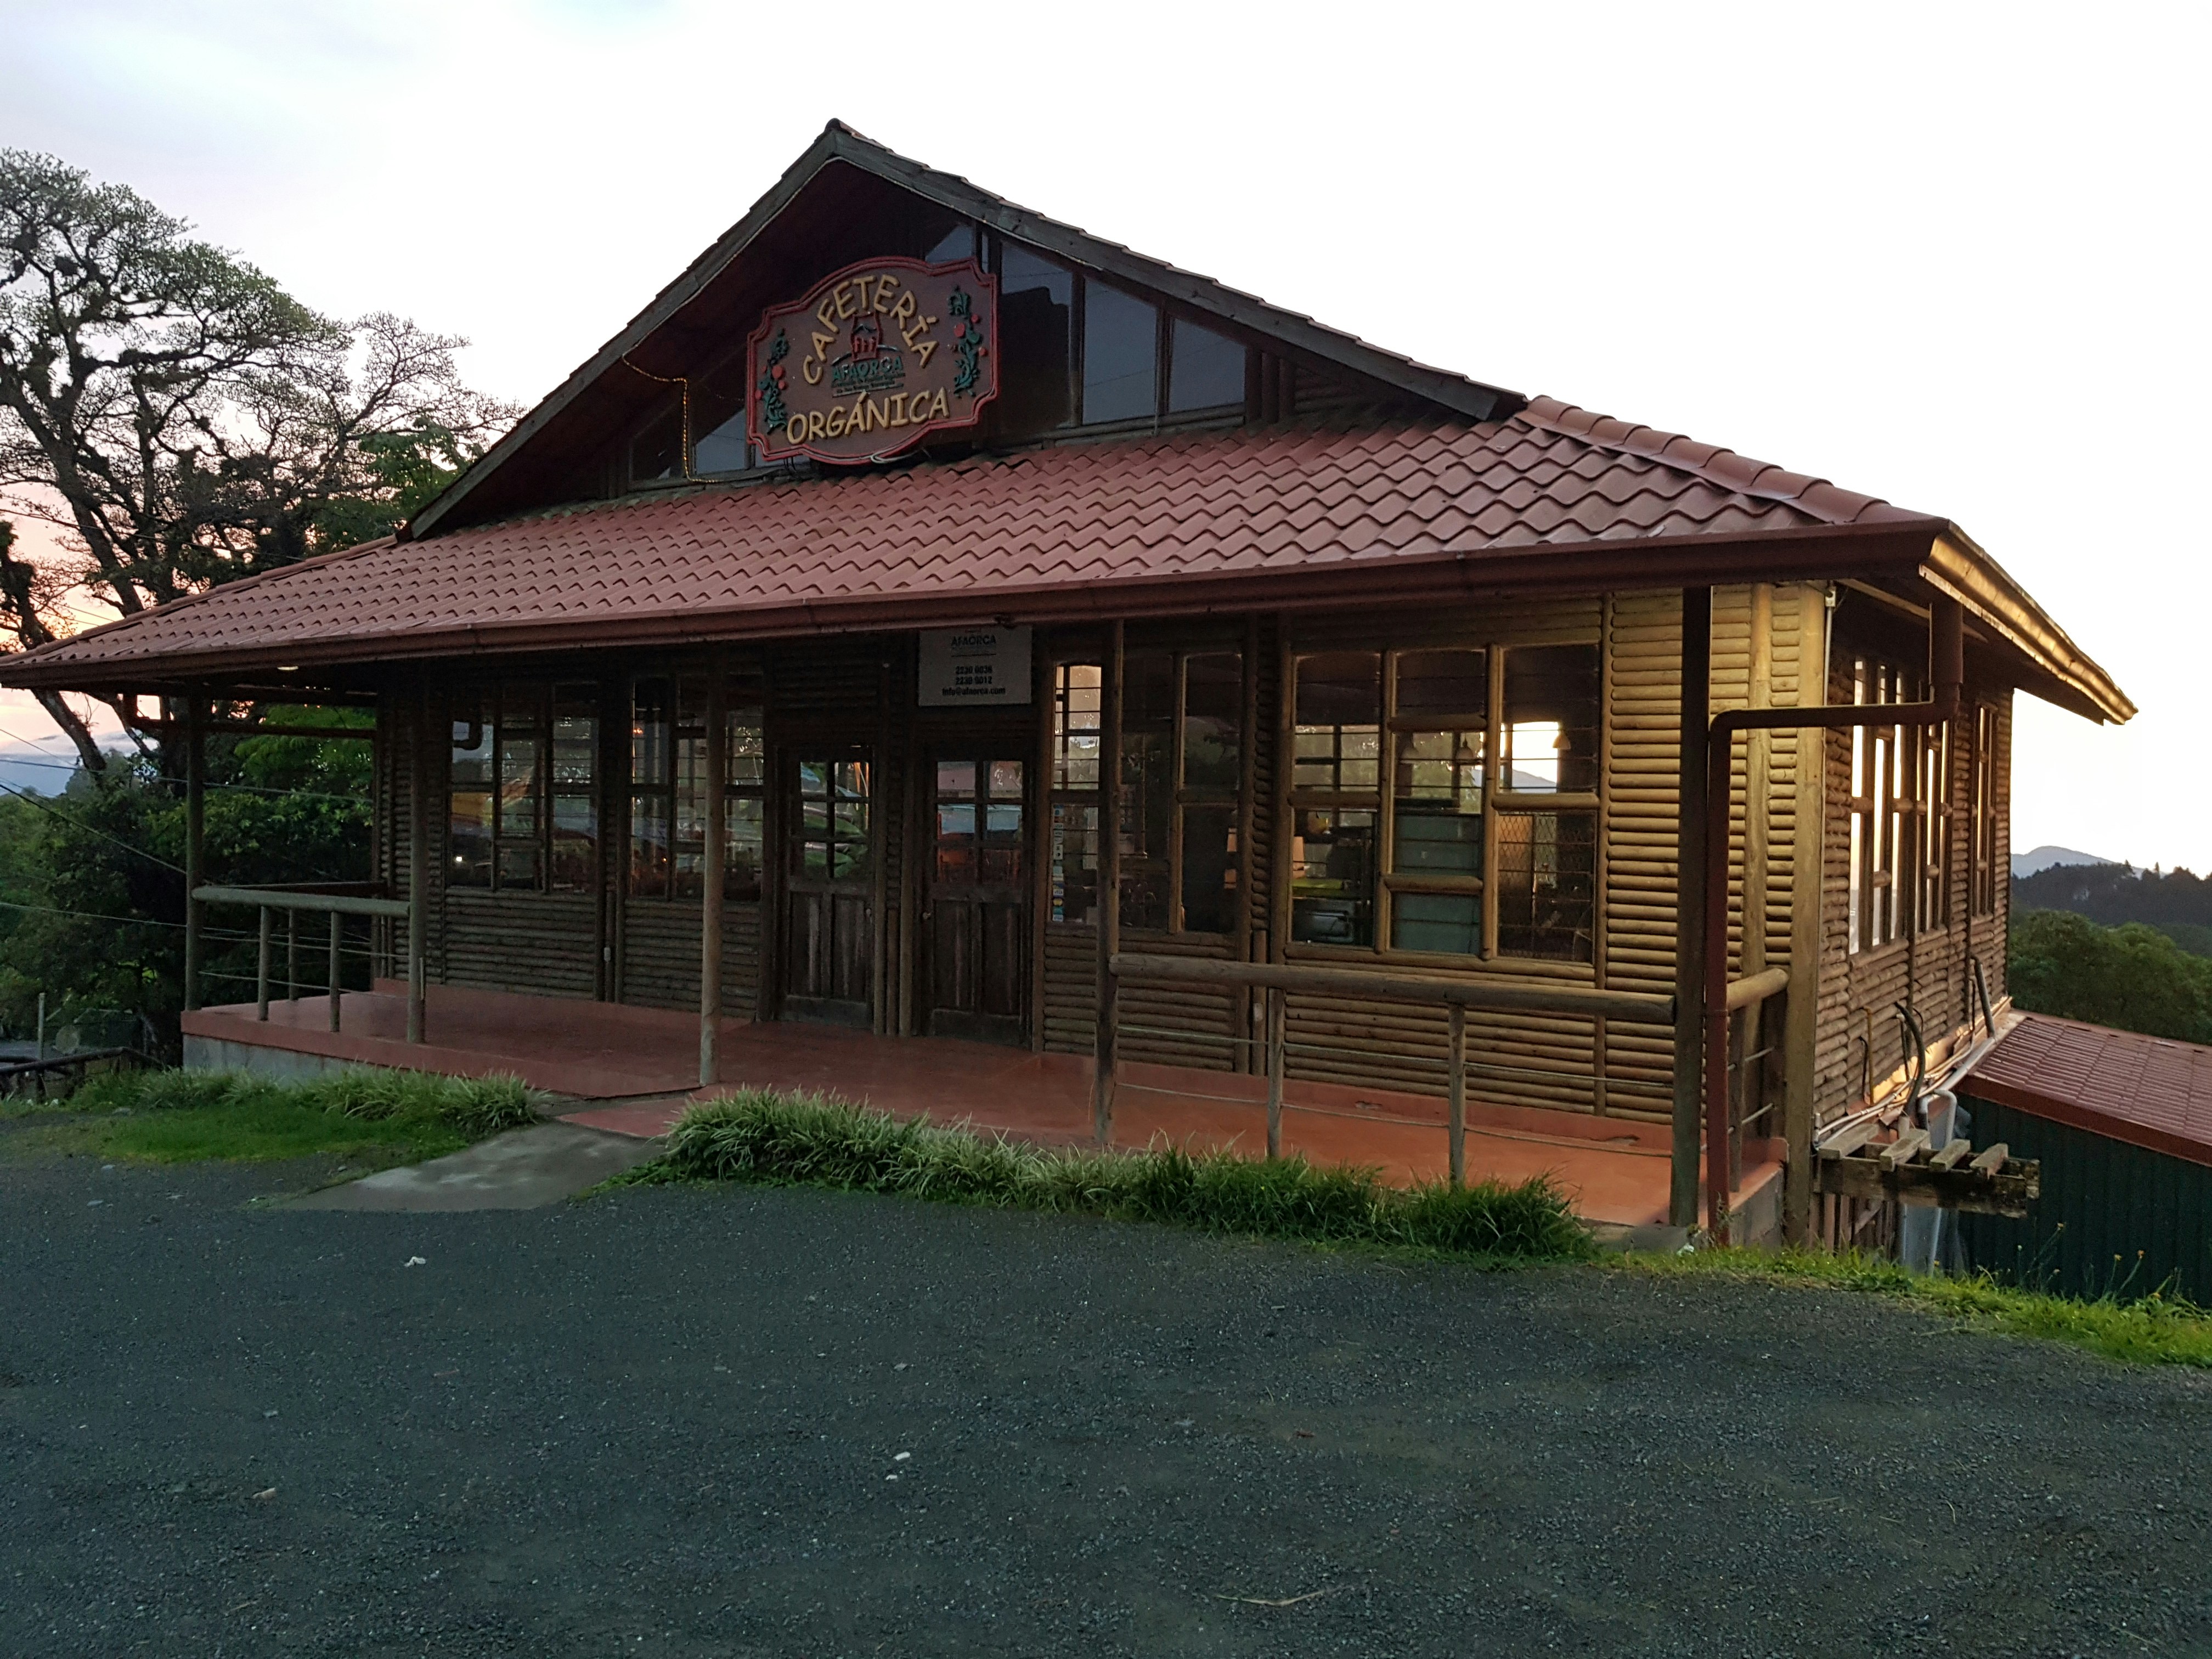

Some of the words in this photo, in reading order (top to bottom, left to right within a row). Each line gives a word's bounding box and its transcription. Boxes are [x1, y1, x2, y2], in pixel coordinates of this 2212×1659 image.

[802, 274, 940, 385] CAFETERÍA
[787, 387, 951, 444] ORGÁNICA
[951, 635, 996, 645] AFAORCA
[942, 687, 1006, 696] info@afaorca.com
